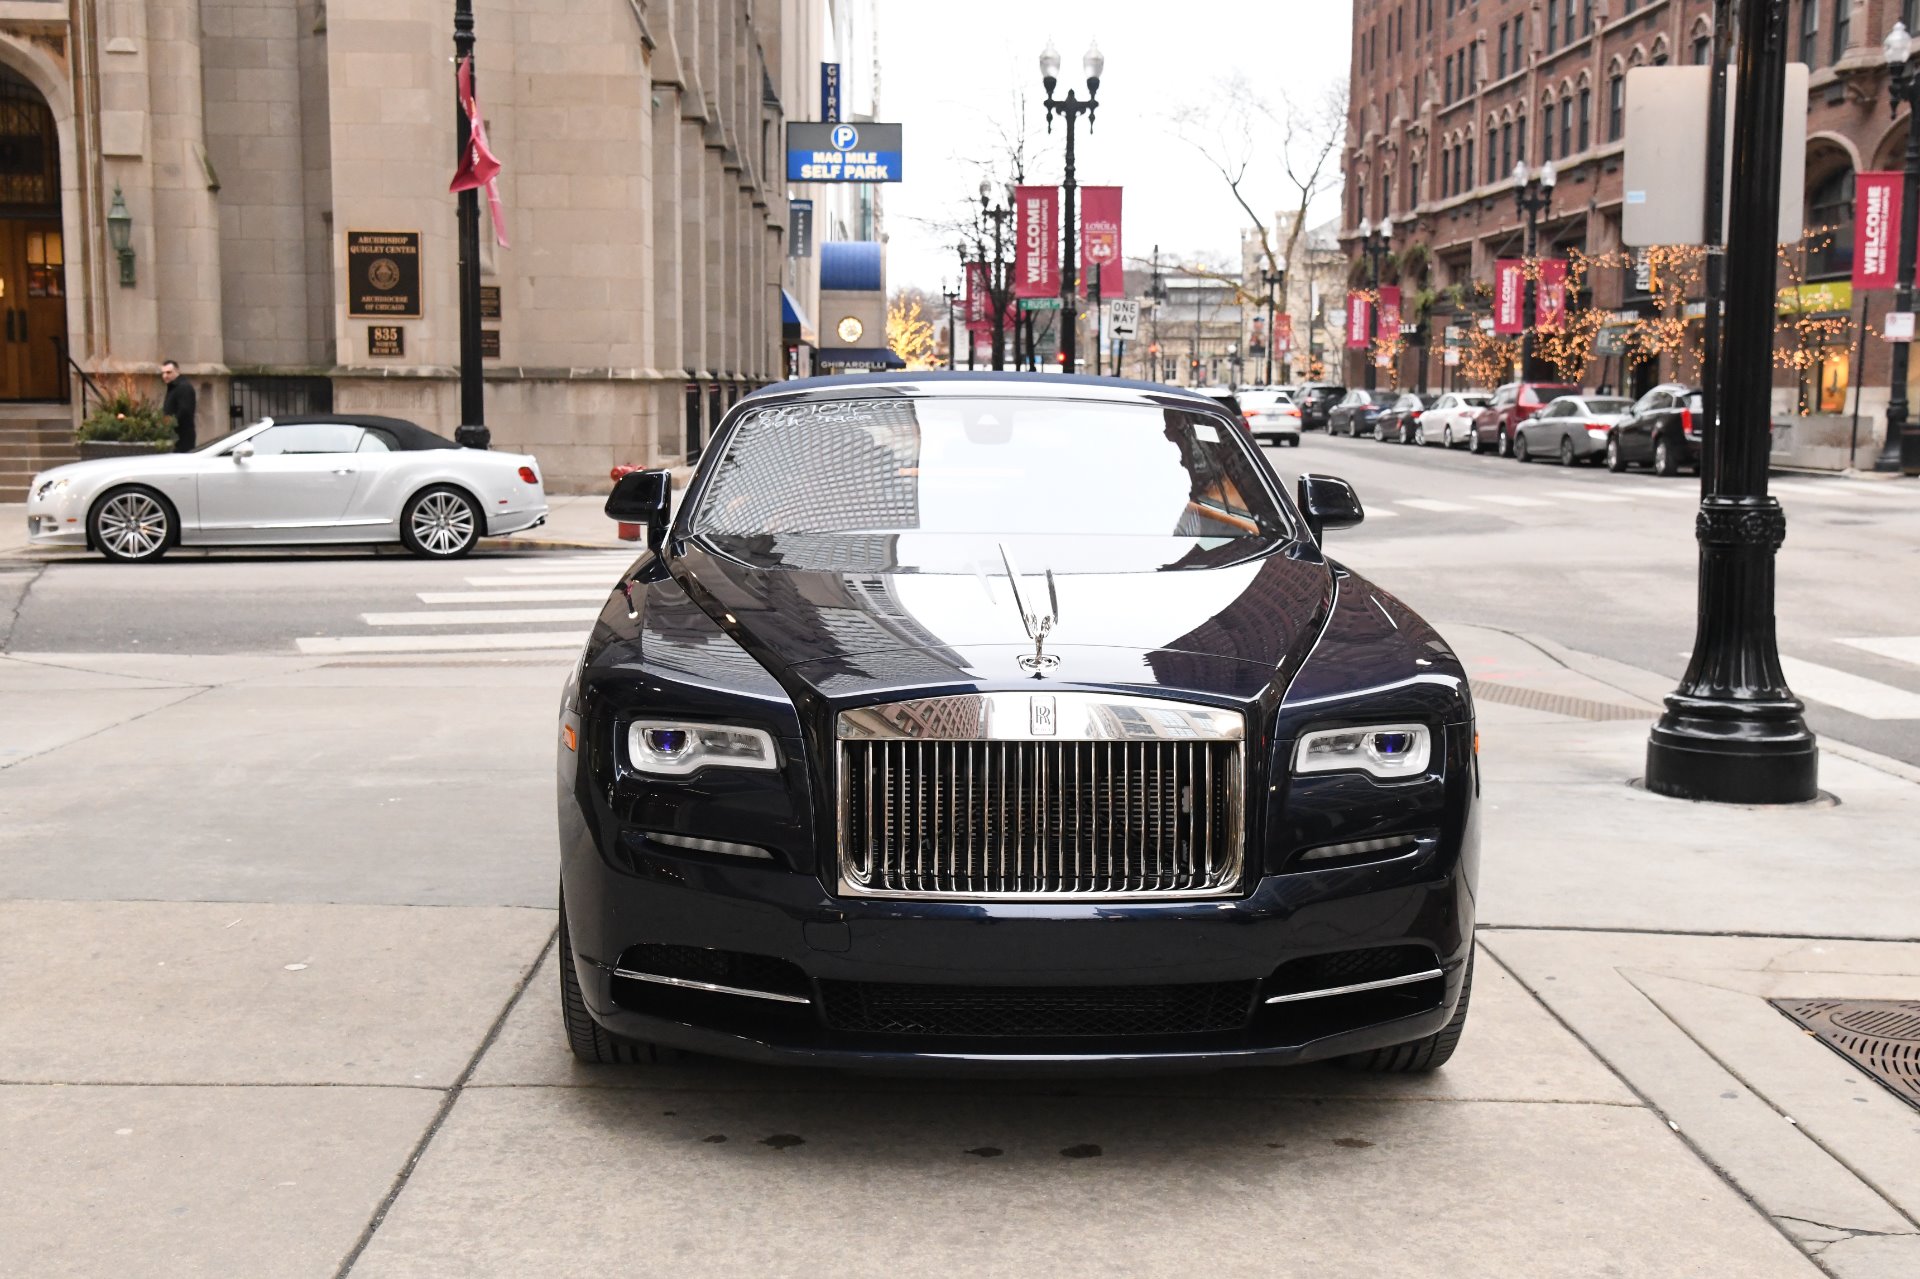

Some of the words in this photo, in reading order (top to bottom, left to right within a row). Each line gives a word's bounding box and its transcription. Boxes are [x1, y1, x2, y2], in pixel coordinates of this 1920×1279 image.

[837, 127, 854, 147] P
[812, 151, 843, 164] MAG
[844, 151, 878, 165] MILE
[801, 164, 842, 179] SELF
[843, 165, 889, 180] PARK
[1864, 186, 1882, 275] WELCOME
[358, 236, 408, 245] ARCHBISHOP
[1027, 198, 1040, 284] WELCOME
[350, 245, 384, 254] QUIGLEY
[385, 246, 416, 254] CENTER
[1501, 268, 1511, 325] WELCOME
[1114, 302, 1136, 313] ONE
[1113, 314, 1136, 324] WAY
[374, 328, 398, 341] 835
[821, 361, 887, 369] GHIRARDELLI
